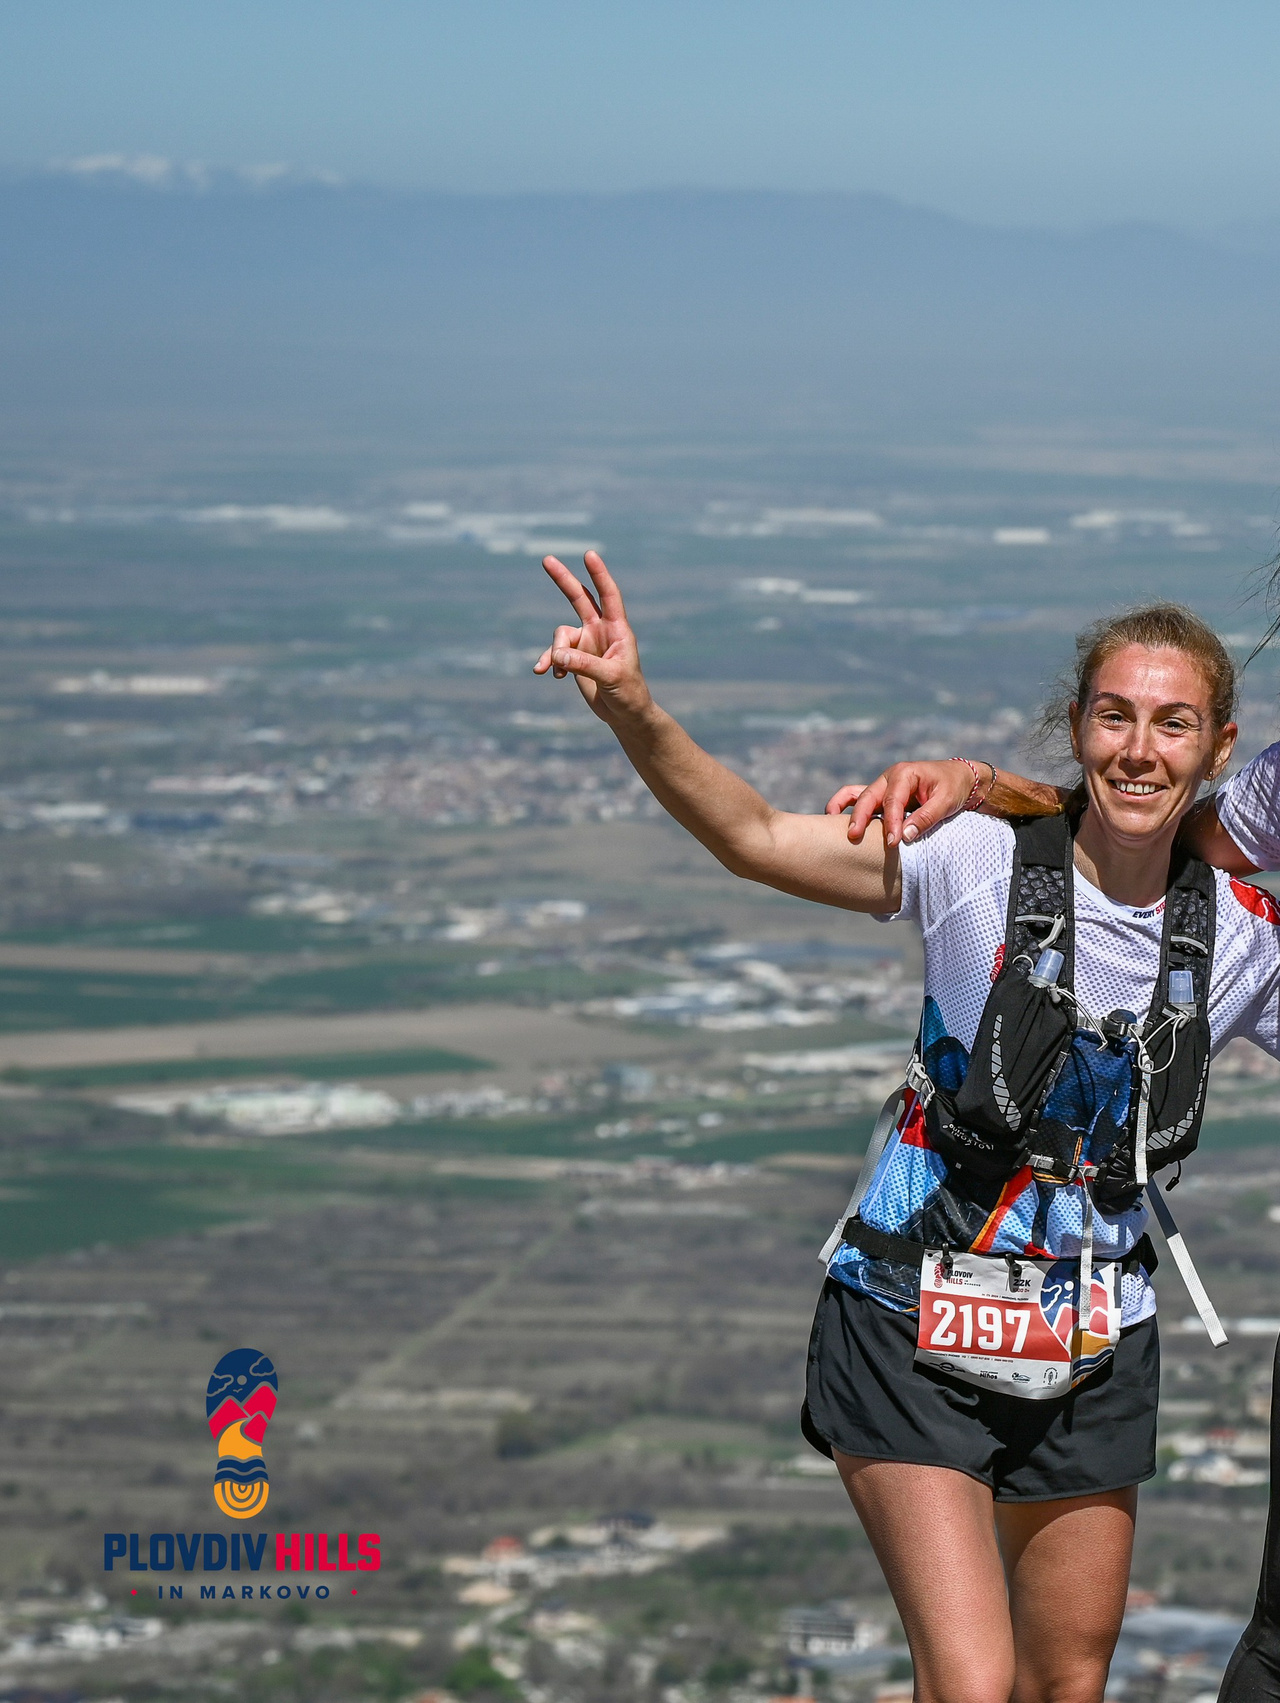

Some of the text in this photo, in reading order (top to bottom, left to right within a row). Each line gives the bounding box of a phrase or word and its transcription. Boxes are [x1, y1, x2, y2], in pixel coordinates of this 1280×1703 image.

[1132, 901, 1166, 919] EVERY STE
[947, 1270, 973, 1279] PLOVDIV
[1013, 1279, 1031, 1287] 22K
[930, 1299, 1031, 1353] 2197
